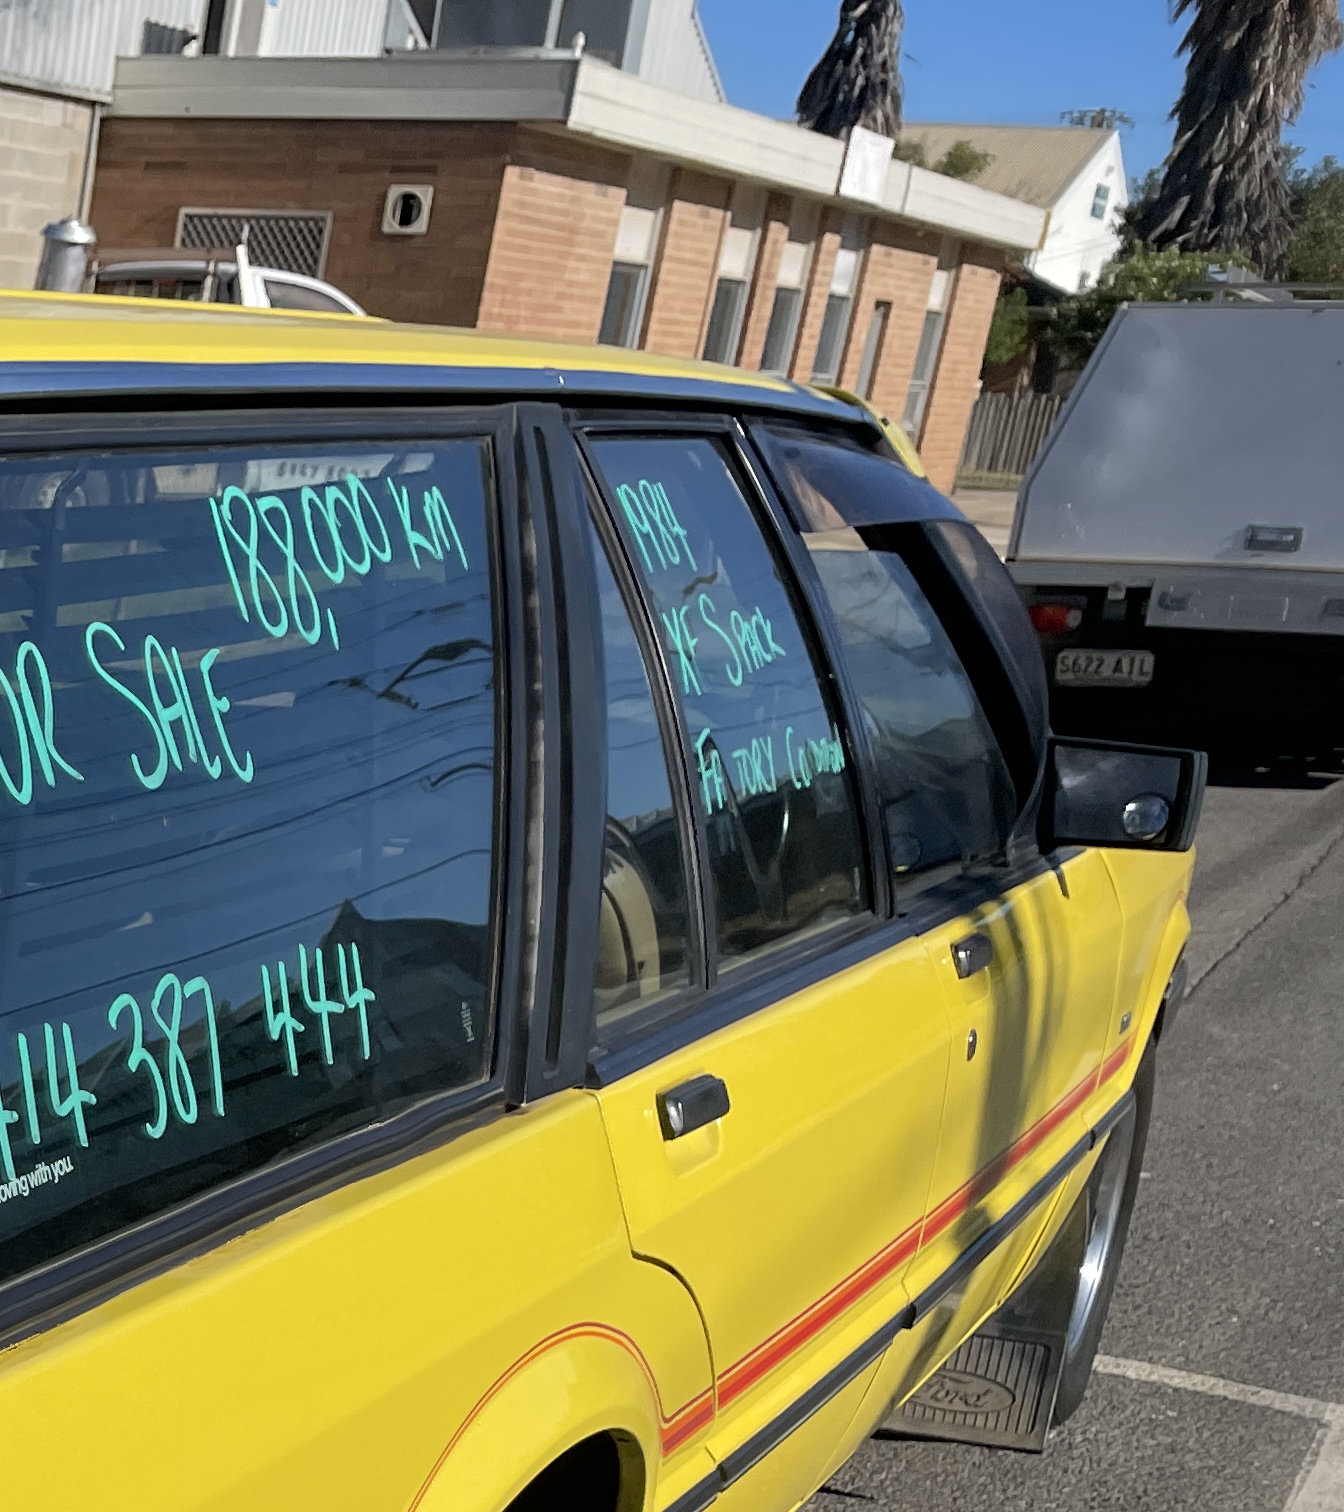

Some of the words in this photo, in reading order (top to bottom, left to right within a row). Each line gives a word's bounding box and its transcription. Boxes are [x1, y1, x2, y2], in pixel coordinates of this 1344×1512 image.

[616, 479, 698, 574] 1984
[85, 620, 255, 790] SALE
[107, 972, 225, 1140] 387
[261, 942, 375, 1077] 444
[28, 1161, 53, 1188] with
